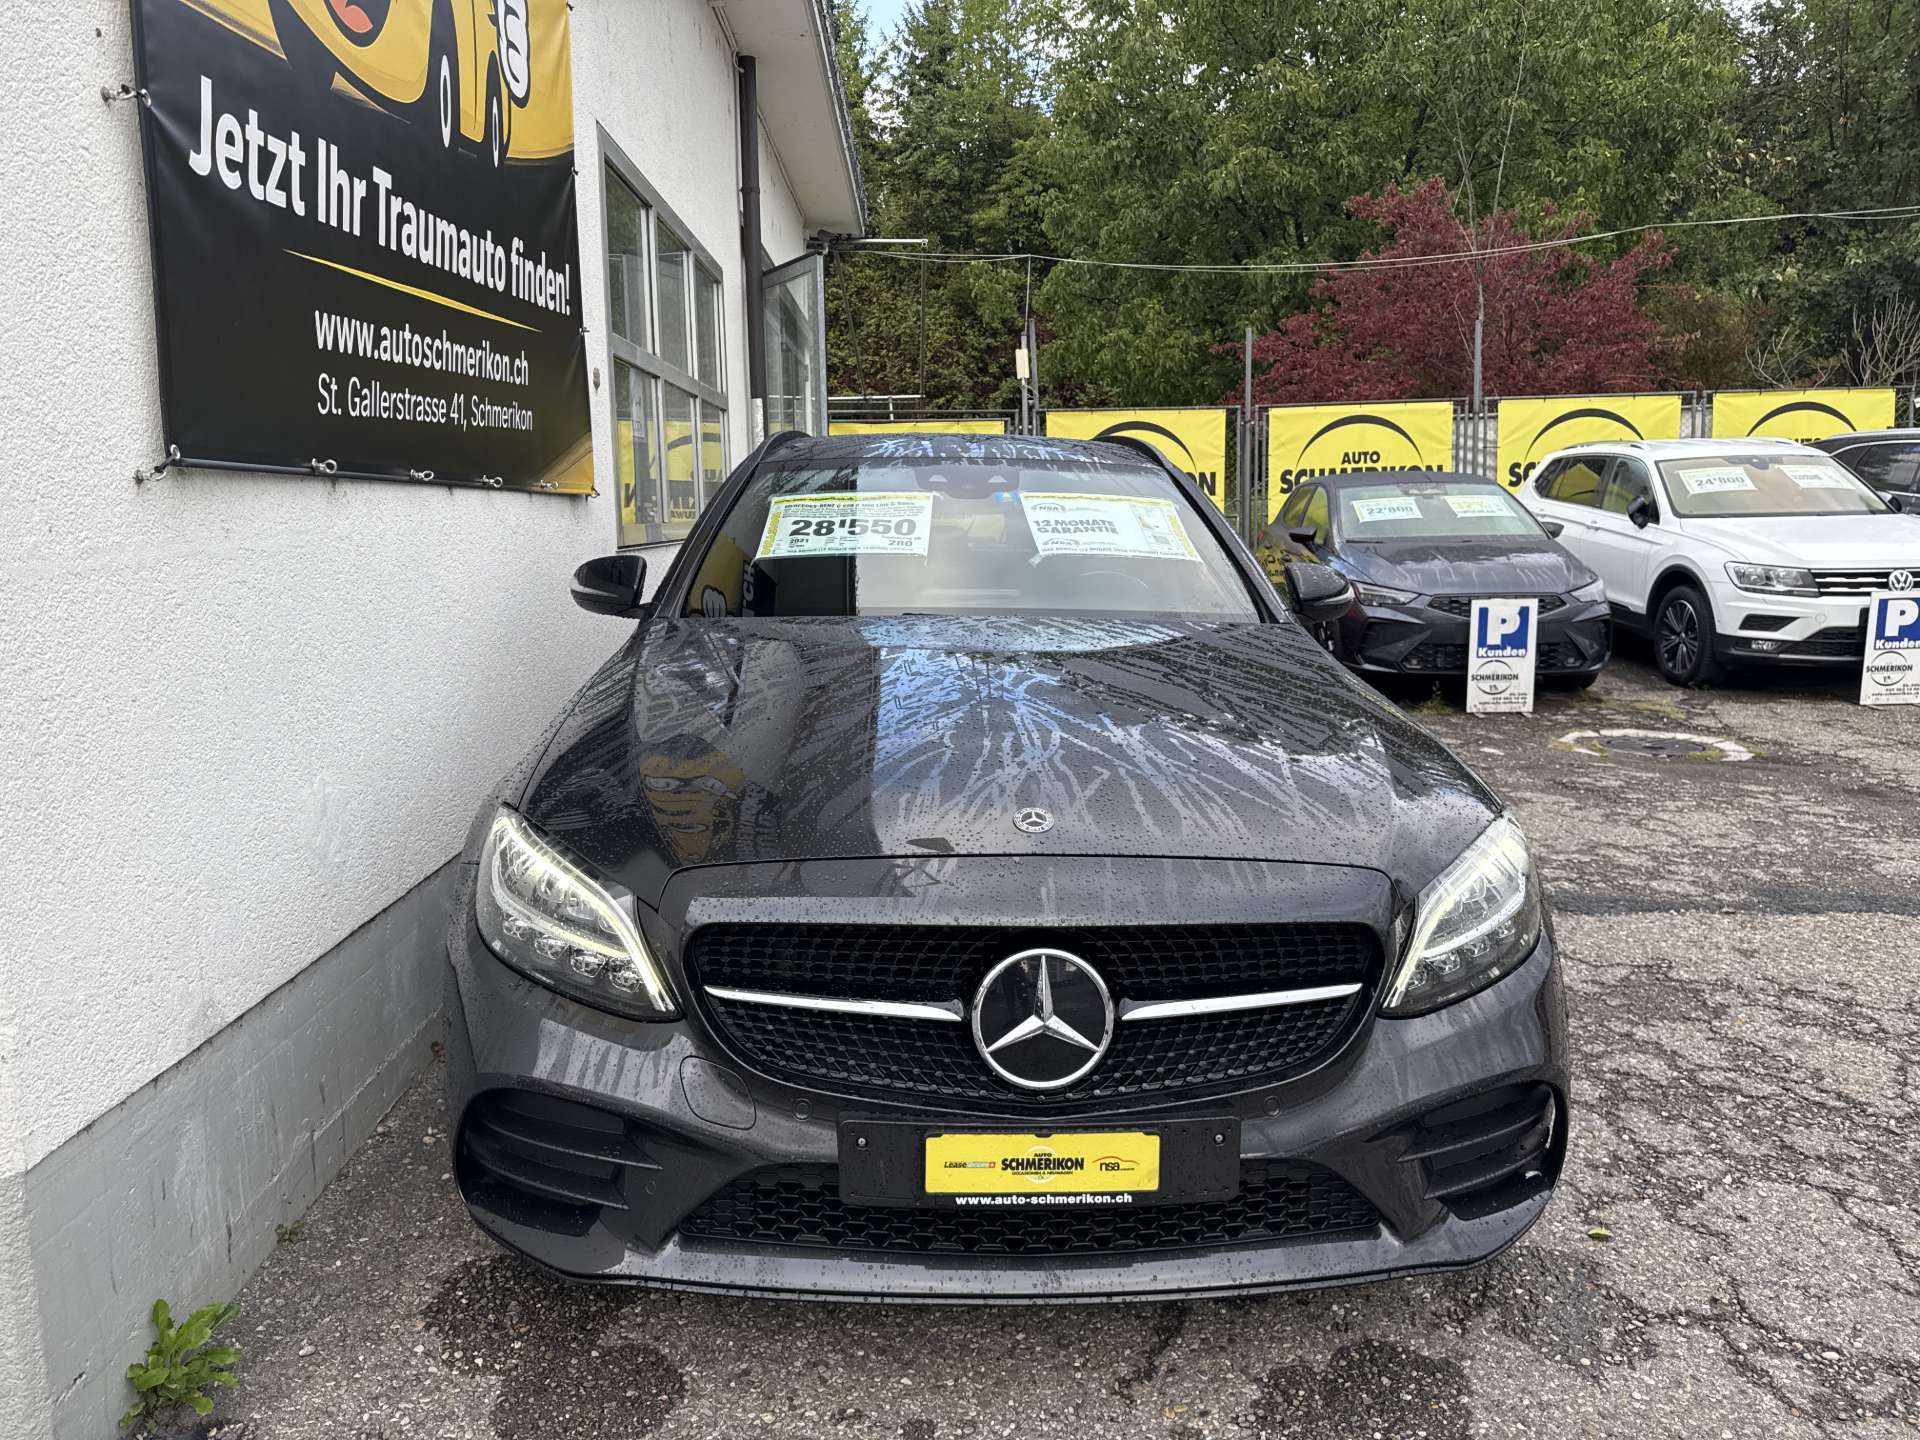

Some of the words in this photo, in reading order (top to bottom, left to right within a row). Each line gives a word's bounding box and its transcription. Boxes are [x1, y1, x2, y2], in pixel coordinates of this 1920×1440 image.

[189, 75, 305, 216] Jetzt
[318, 137, 367, 237] Ihr
[373, 166, 506, 292] Traumauto
[511, 236, 570, 316] finden!
[315, 310, 529, 386] www.autoschmerikon.ch
[317, 372, 342, 416] St.
[348, 376, 447, 424] Gallerstrasse
[450, 392, 467, 432] 41,
[471, 394, 533, 431] Schmerikon
[1341, 451, 1381, 465] AUTO
[789, 518, 916, 537] 28'550
[1054, 519, 1115, 528] MONATE
[1037, 526, 1119, 535] GARANTIE
[1884, 599, 1919, 637] P
[1487, 606, 1521, 646] P
[1876, 637, 1920, 650] Kunden
[1478, 646, 1526, 658] Kunden
[1866, 664, 1913, 673] SCHMERIKON
[1471, 673, 1519, 682] SCHMERIKON
[1001, 1157, 1084, 1171] SCHMERIKON
[1100, 1160, 1120, 1172] nsa
[955, 1193, 1133, 1205] www.auto-schmerikon.ch
